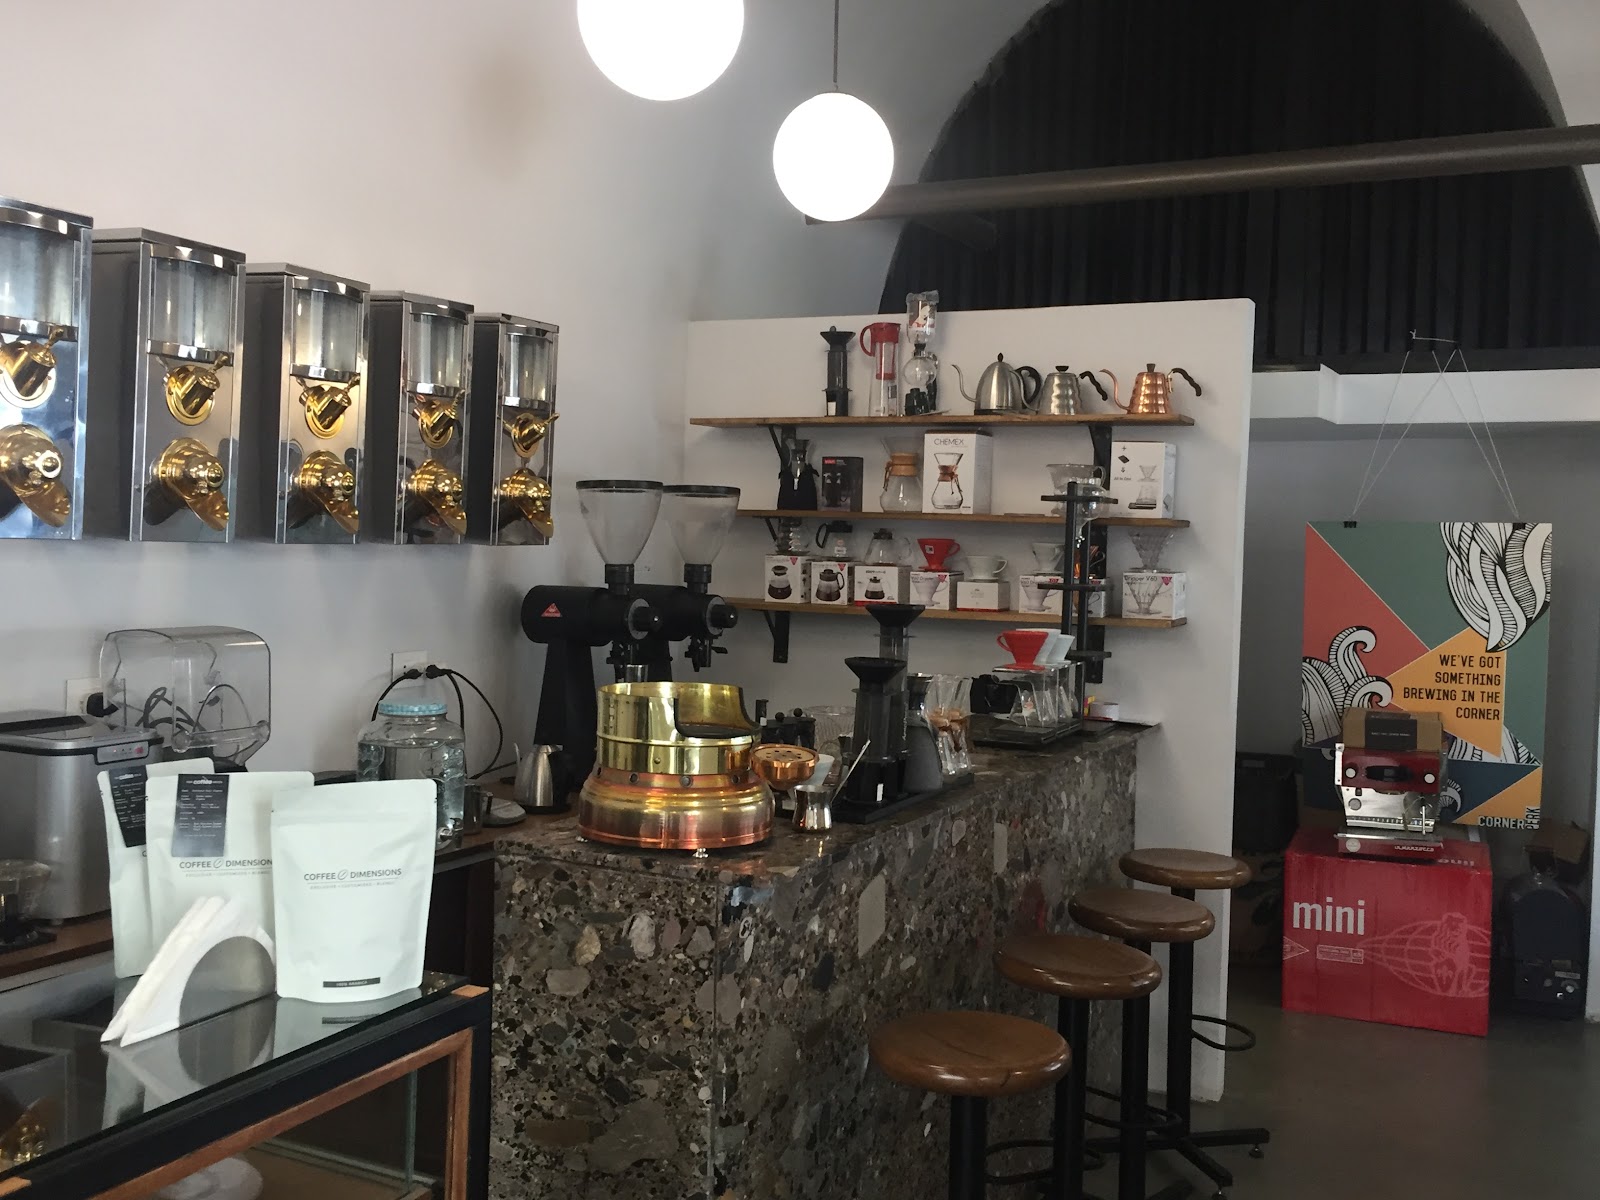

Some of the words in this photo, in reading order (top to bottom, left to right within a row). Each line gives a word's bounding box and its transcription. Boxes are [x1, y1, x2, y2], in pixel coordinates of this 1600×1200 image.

[933, 438, 964, 446] CHEMEX
[1439, 654, 1475, 668] WE'VE
[1479, 656, 1502, 669] GOT
[1435, 671, 1501, 686] SOMETHING
[1403, 687, 1457, 701] BREWING
[1461, 690, 1475, 702] IN
[1481, 691, 1500, 704] THE
[1455, 707, 1500, 721] CORNER
[1478, 815, 1525, 830] CORNER
[179, 860, 212, 869] COFFEE
[225, 859, 273, 868] DIMENSION
[304, 873, 336, 881] COFFEE
[350, 868, 402, 879] DIMENSIONS
[1292, 896, 1365, 935] mini
